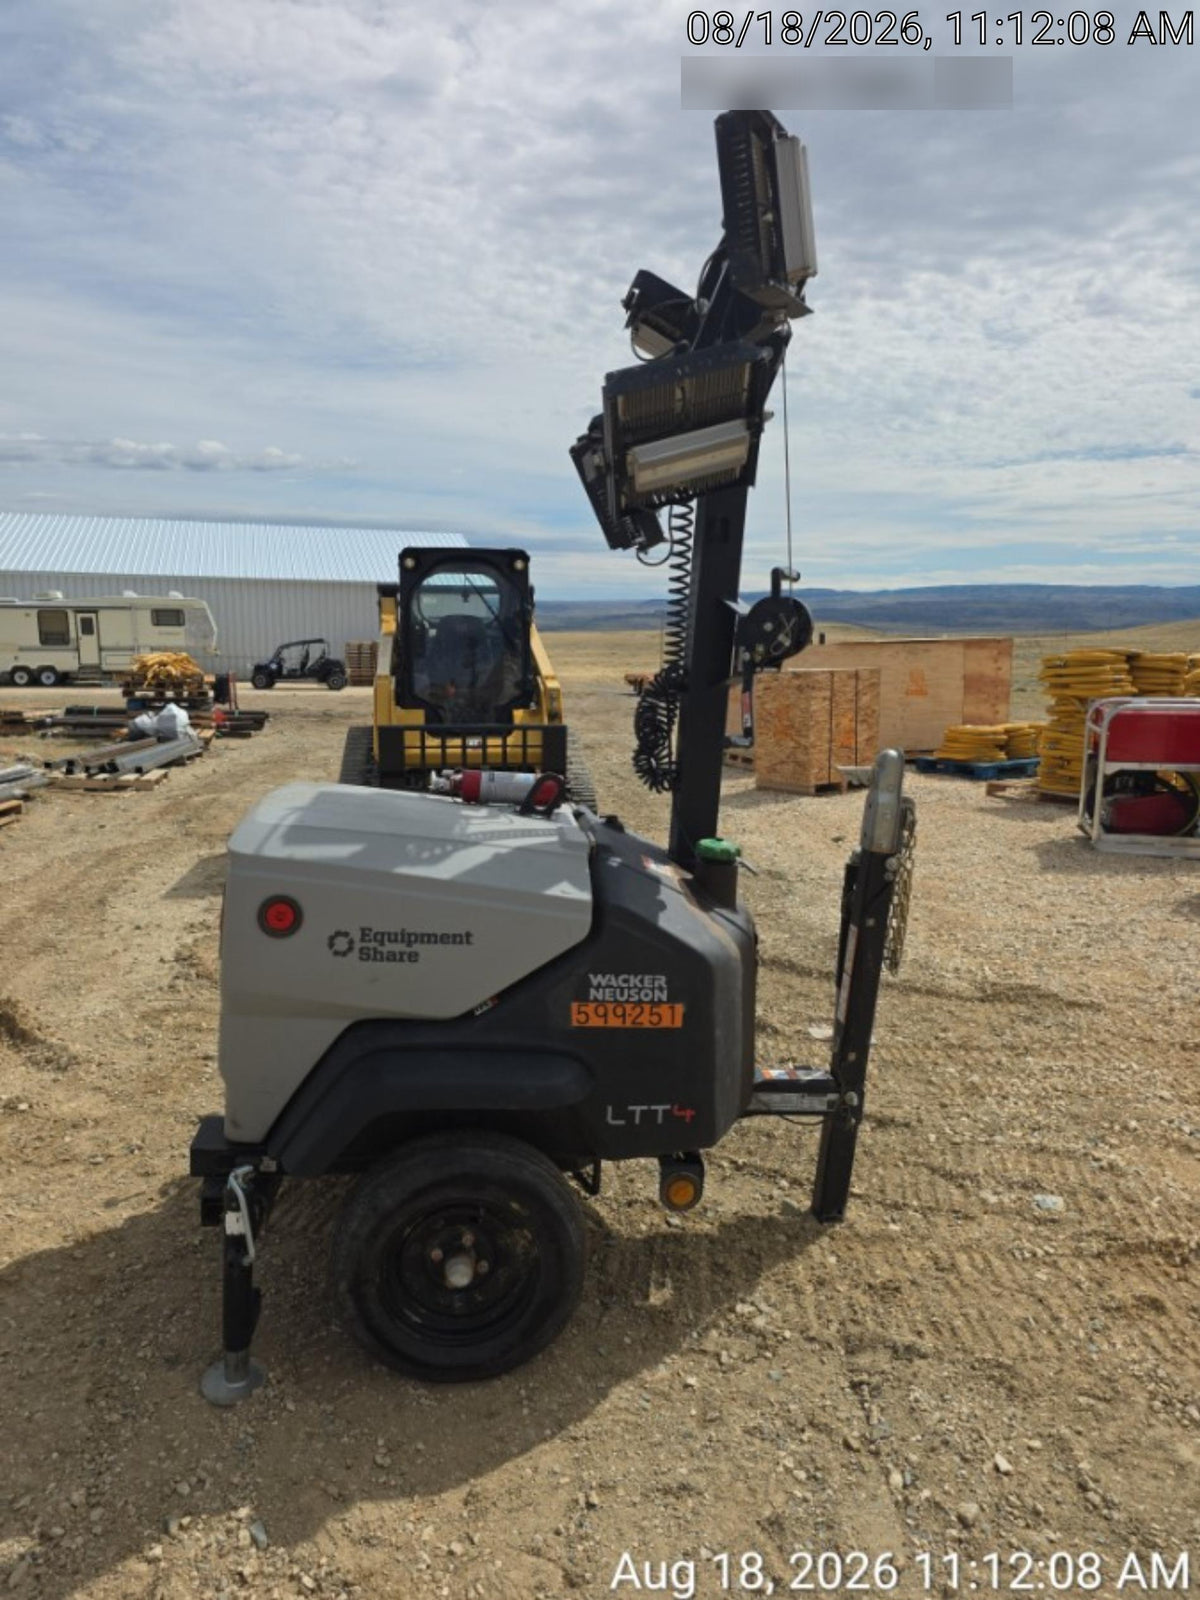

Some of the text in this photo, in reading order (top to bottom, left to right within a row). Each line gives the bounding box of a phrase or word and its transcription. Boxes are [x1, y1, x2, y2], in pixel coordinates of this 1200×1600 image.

[359, 927, 474, 947] Equipment
[358, 946, 420, 963] Share
[588, 973, 667, 988] WACKER
[589, 988, 668, 1002] NEUSON
